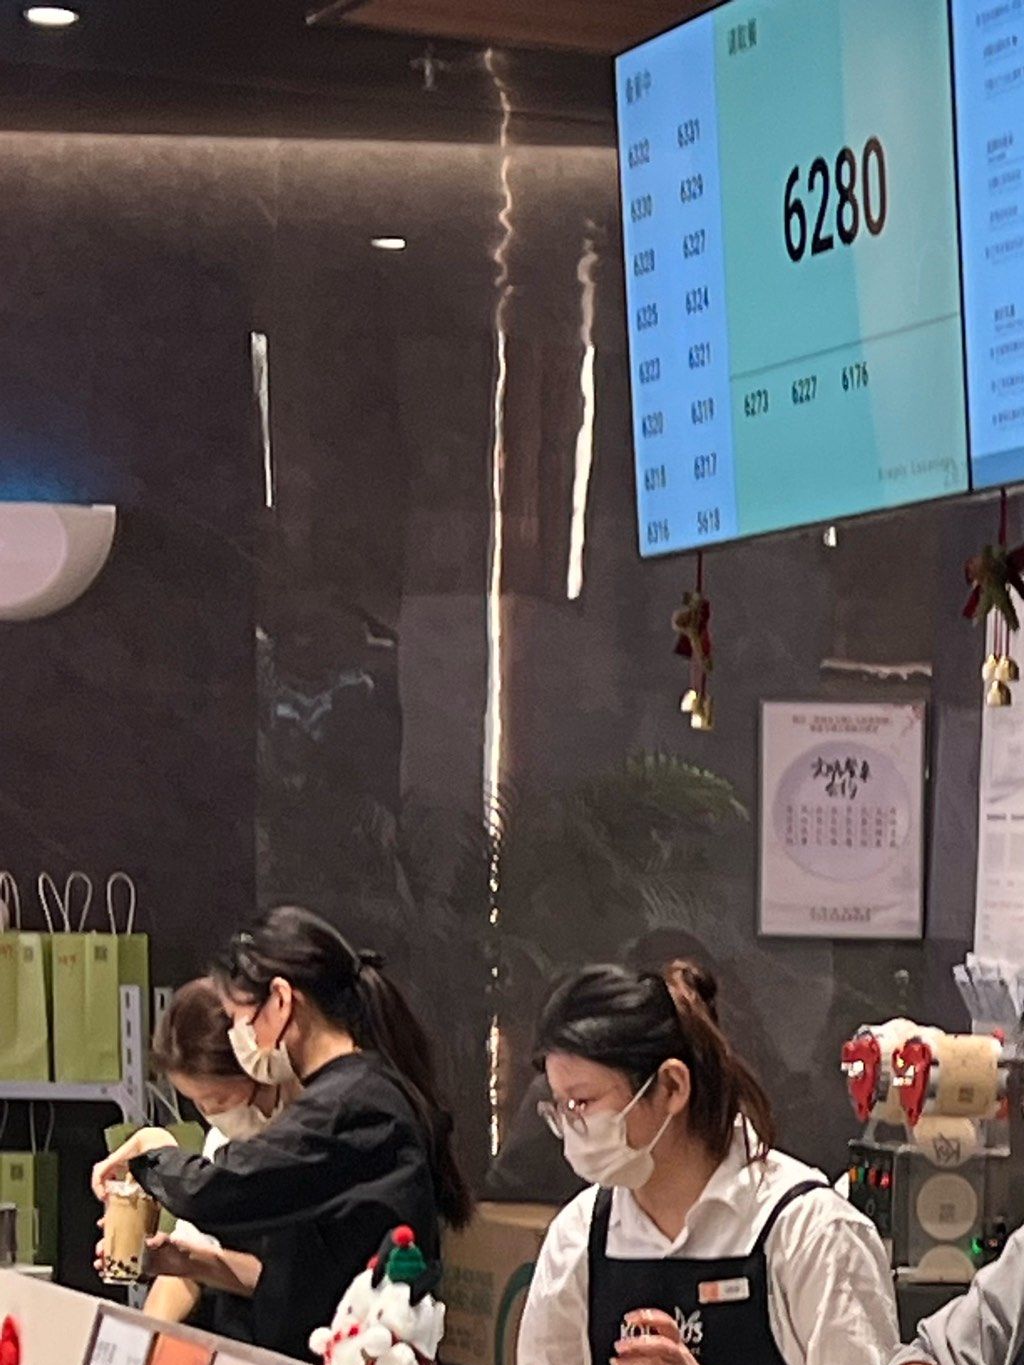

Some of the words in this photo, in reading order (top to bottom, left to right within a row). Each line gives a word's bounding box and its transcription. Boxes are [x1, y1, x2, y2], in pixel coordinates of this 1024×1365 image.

[783, 135, 887, 263] 6280
[683, 229, 705, 259] 6327
[744, 389, 769, 418] 6273
[792, 374, 817, 405] 6227
[841, 361, 869, 392] 6176
[694, 452, 717, 481] 6317
[647, 518, 670, 545] 6316
